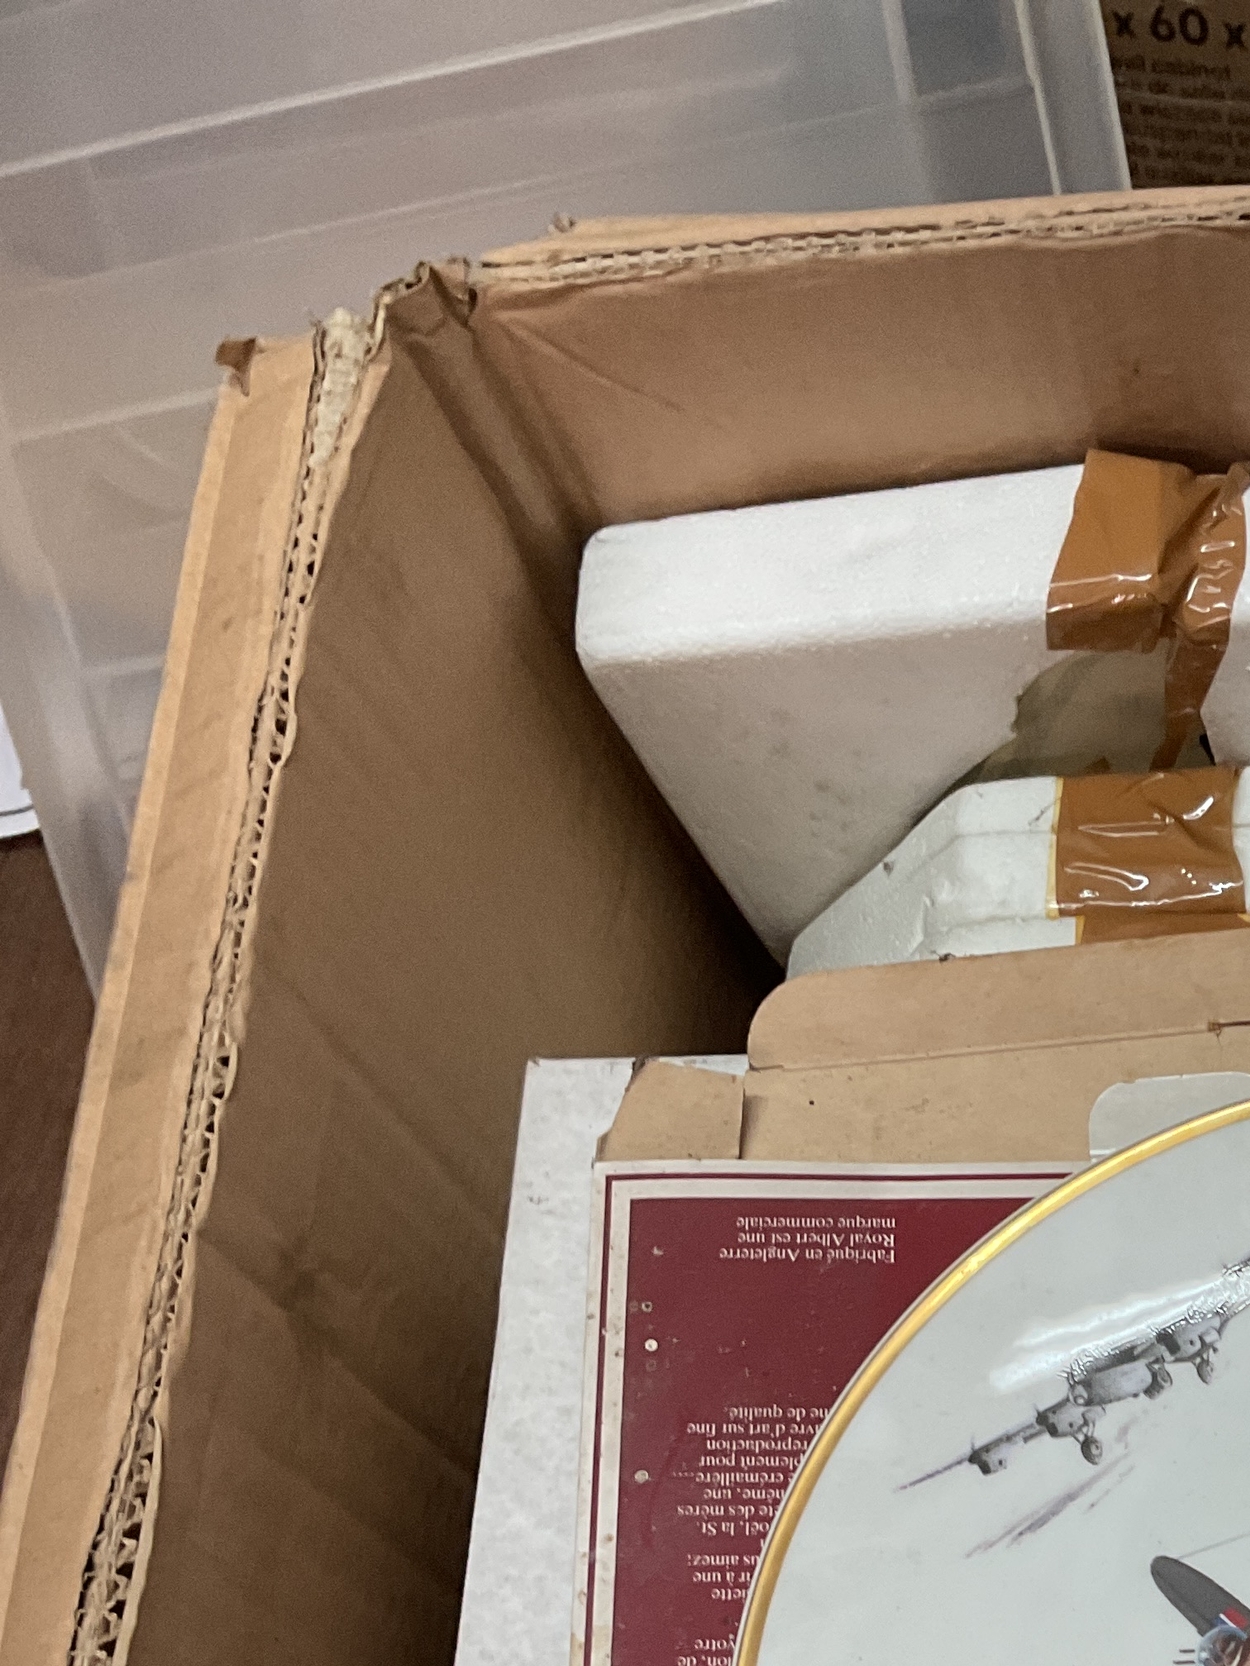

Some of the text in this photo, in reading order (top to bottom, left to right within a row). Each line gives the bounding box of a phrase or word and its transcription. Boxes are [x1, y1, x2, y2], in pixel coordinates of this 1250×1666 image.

[1112, 10, 1136, 39] x
[1150, 5, 1210, 46] 60
[1223, 21, 1247, 50] x
[736, 1215, 896, 1231] marque commerciale
[737, 1230, 895, 1247] Royal Albert est une
[718, 1246, 895, 1263] Fabriqué en Angleterre
[787, 1407, 806, 1422] de
[687, 1422, 716, 1437] fine
[722, 1422, 745, 1435] sur
[749, 1423, 786, 1438] d'art
[706, 1436, 807, 1453] reproduction
[699, 1453, 804, 1470] plement pour
[703, 1488, 732, 1499] une
[677, 1505, 724, 1519] mères
[728, 1505, 755, 1520] des
[721, 1522, 734, 1536] la
[739, 1521, 769, 1536] oël,
[692, 1571, 721, 1583] une
[726, 1571, 735, 1586] à
[711, 1588, 750, 1602] iette
[694, 1638, 736, 1651] votre
